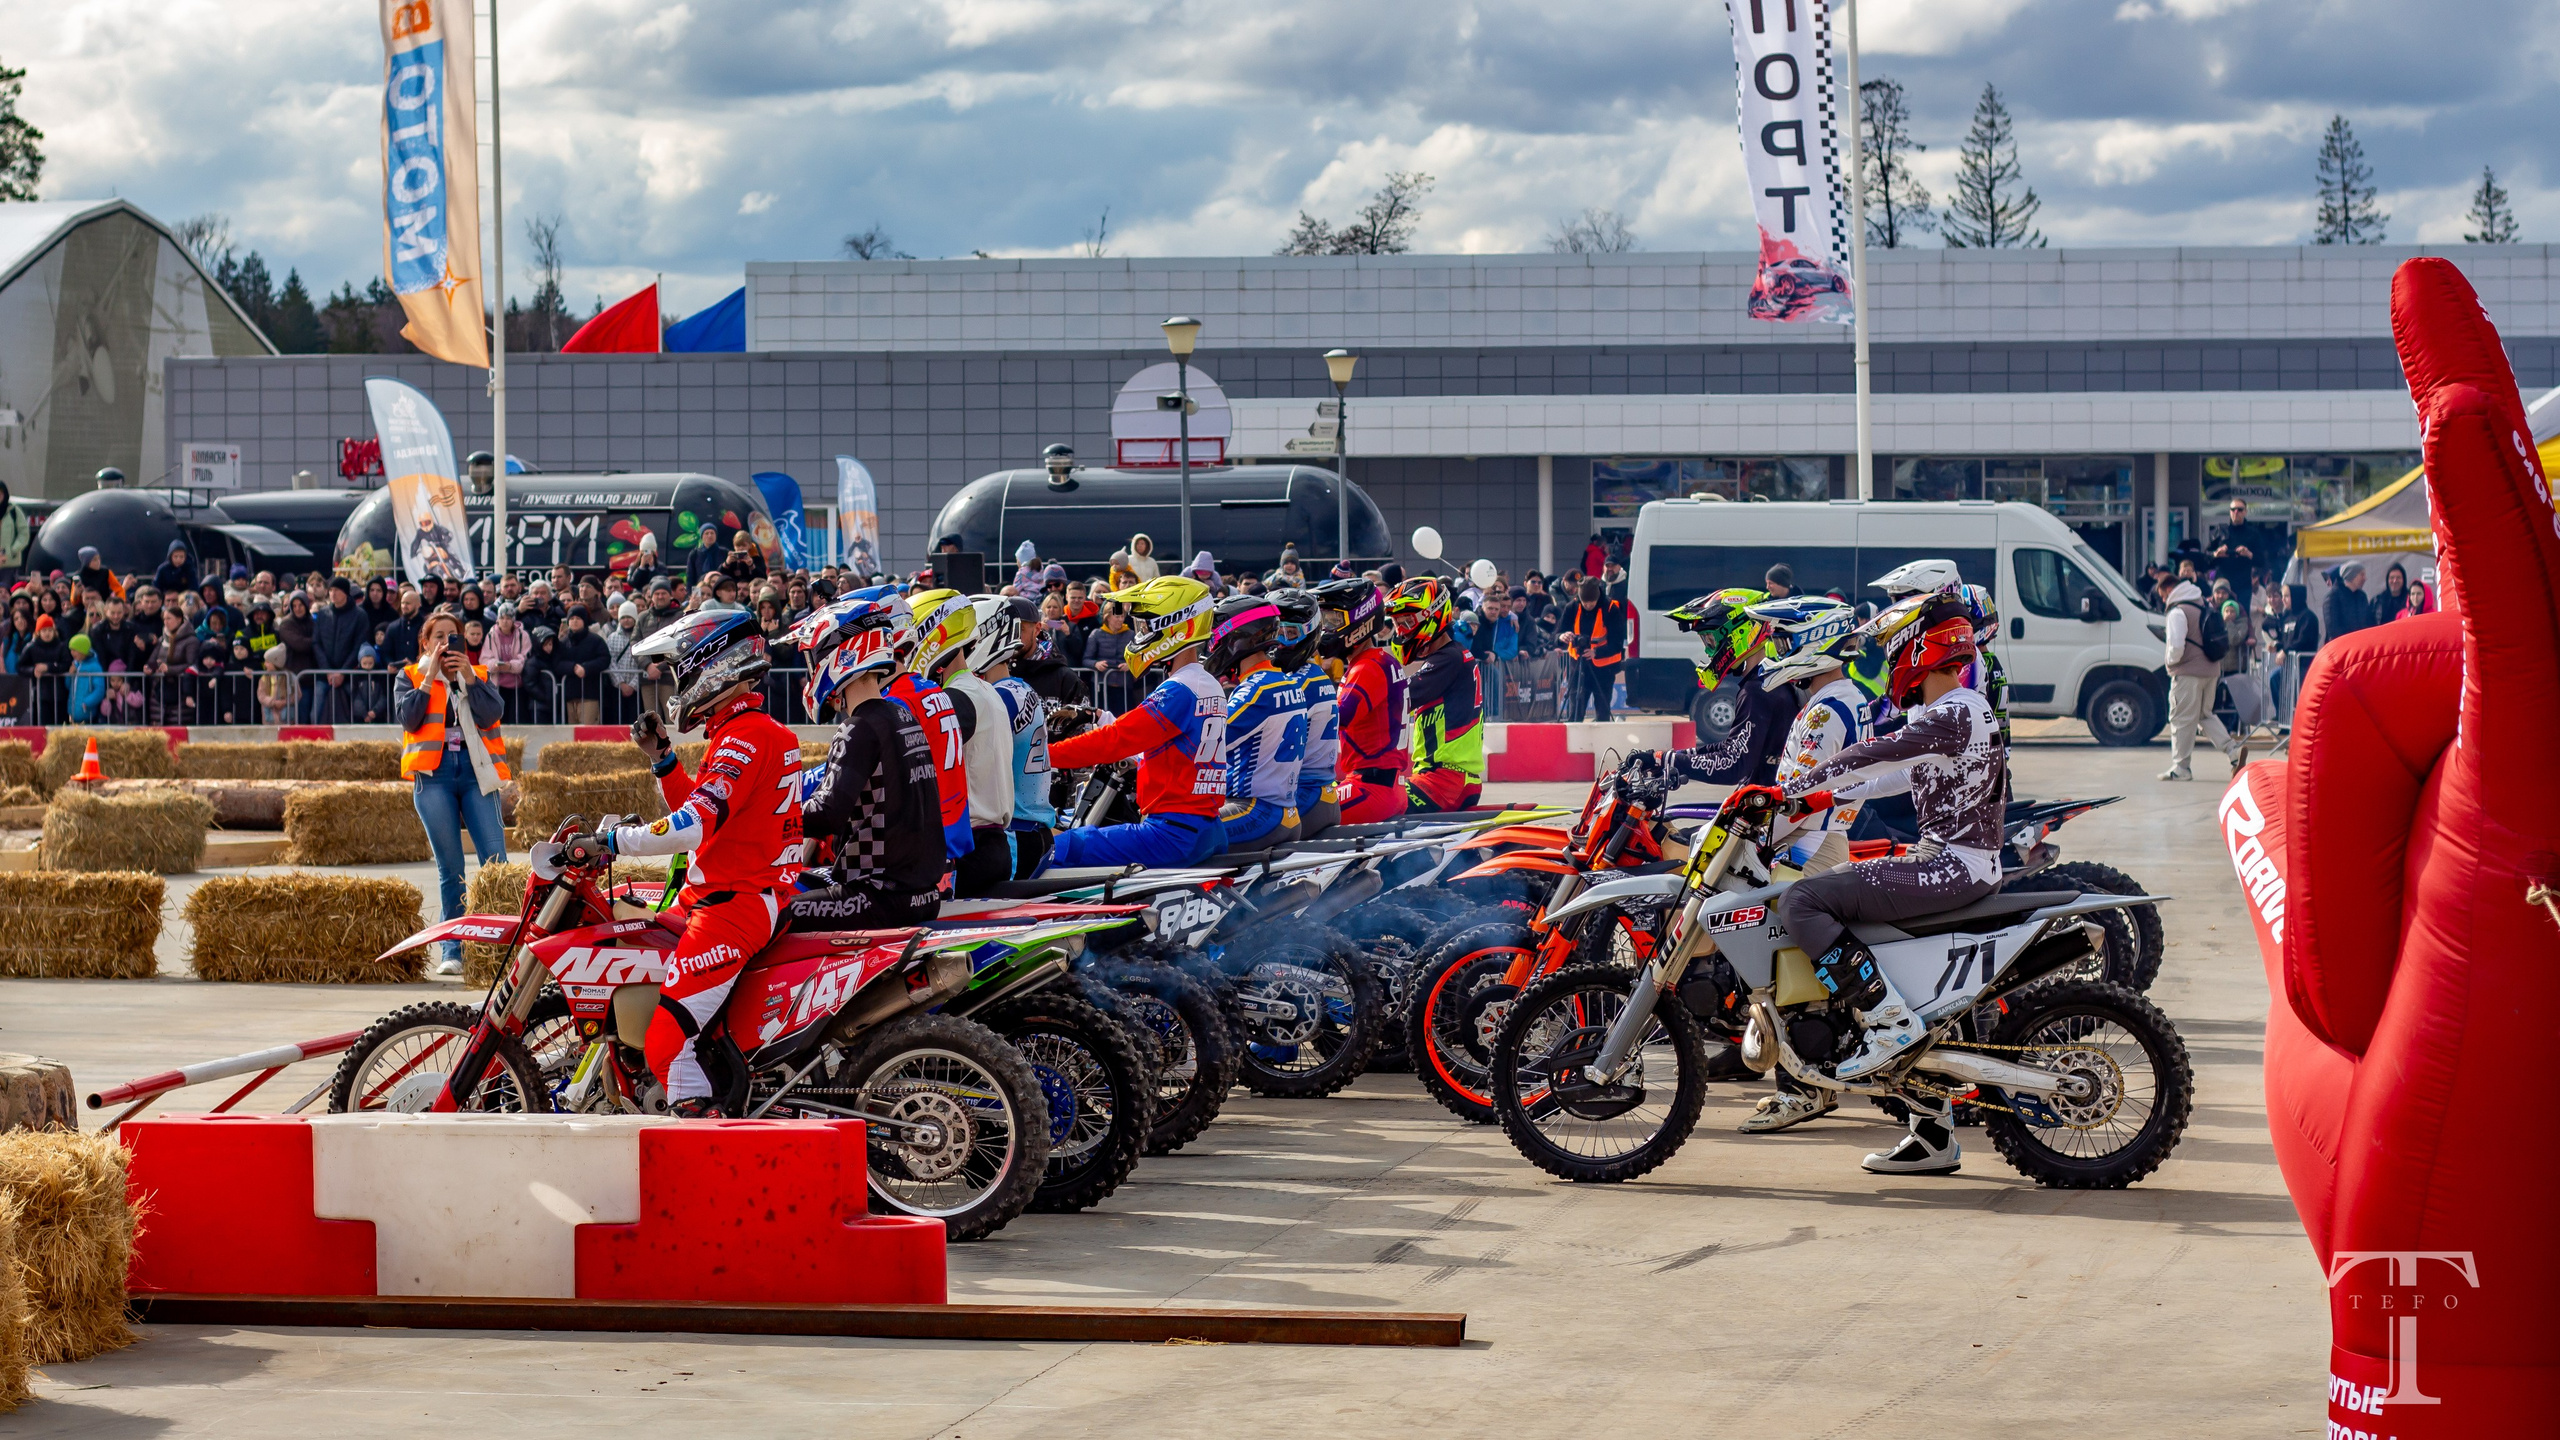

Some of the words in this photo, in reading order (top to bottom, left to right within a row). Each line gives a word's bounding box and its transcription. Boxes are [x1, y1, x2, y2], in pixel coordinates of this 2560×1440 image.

[525, 494, 571, 505] ЛУЧШЕЕ
[575, 494, 620, 505] НАЧАЛО
[1153, 604, 1196, 632] 100%
[1800, 619, 1856, 646] 100%
[1141, 631, 1187, 663] invoke
[447, 924, 505, 940] ARNES
[613, 925, 624, 934] RED
[625, 921, 646, 932] ROCKET
[1767, 925, 1789, 941] ДА
[790, 959, 866, 1026] 747
[1937, 997, 1969, 1017] ДАРКСАЙД
